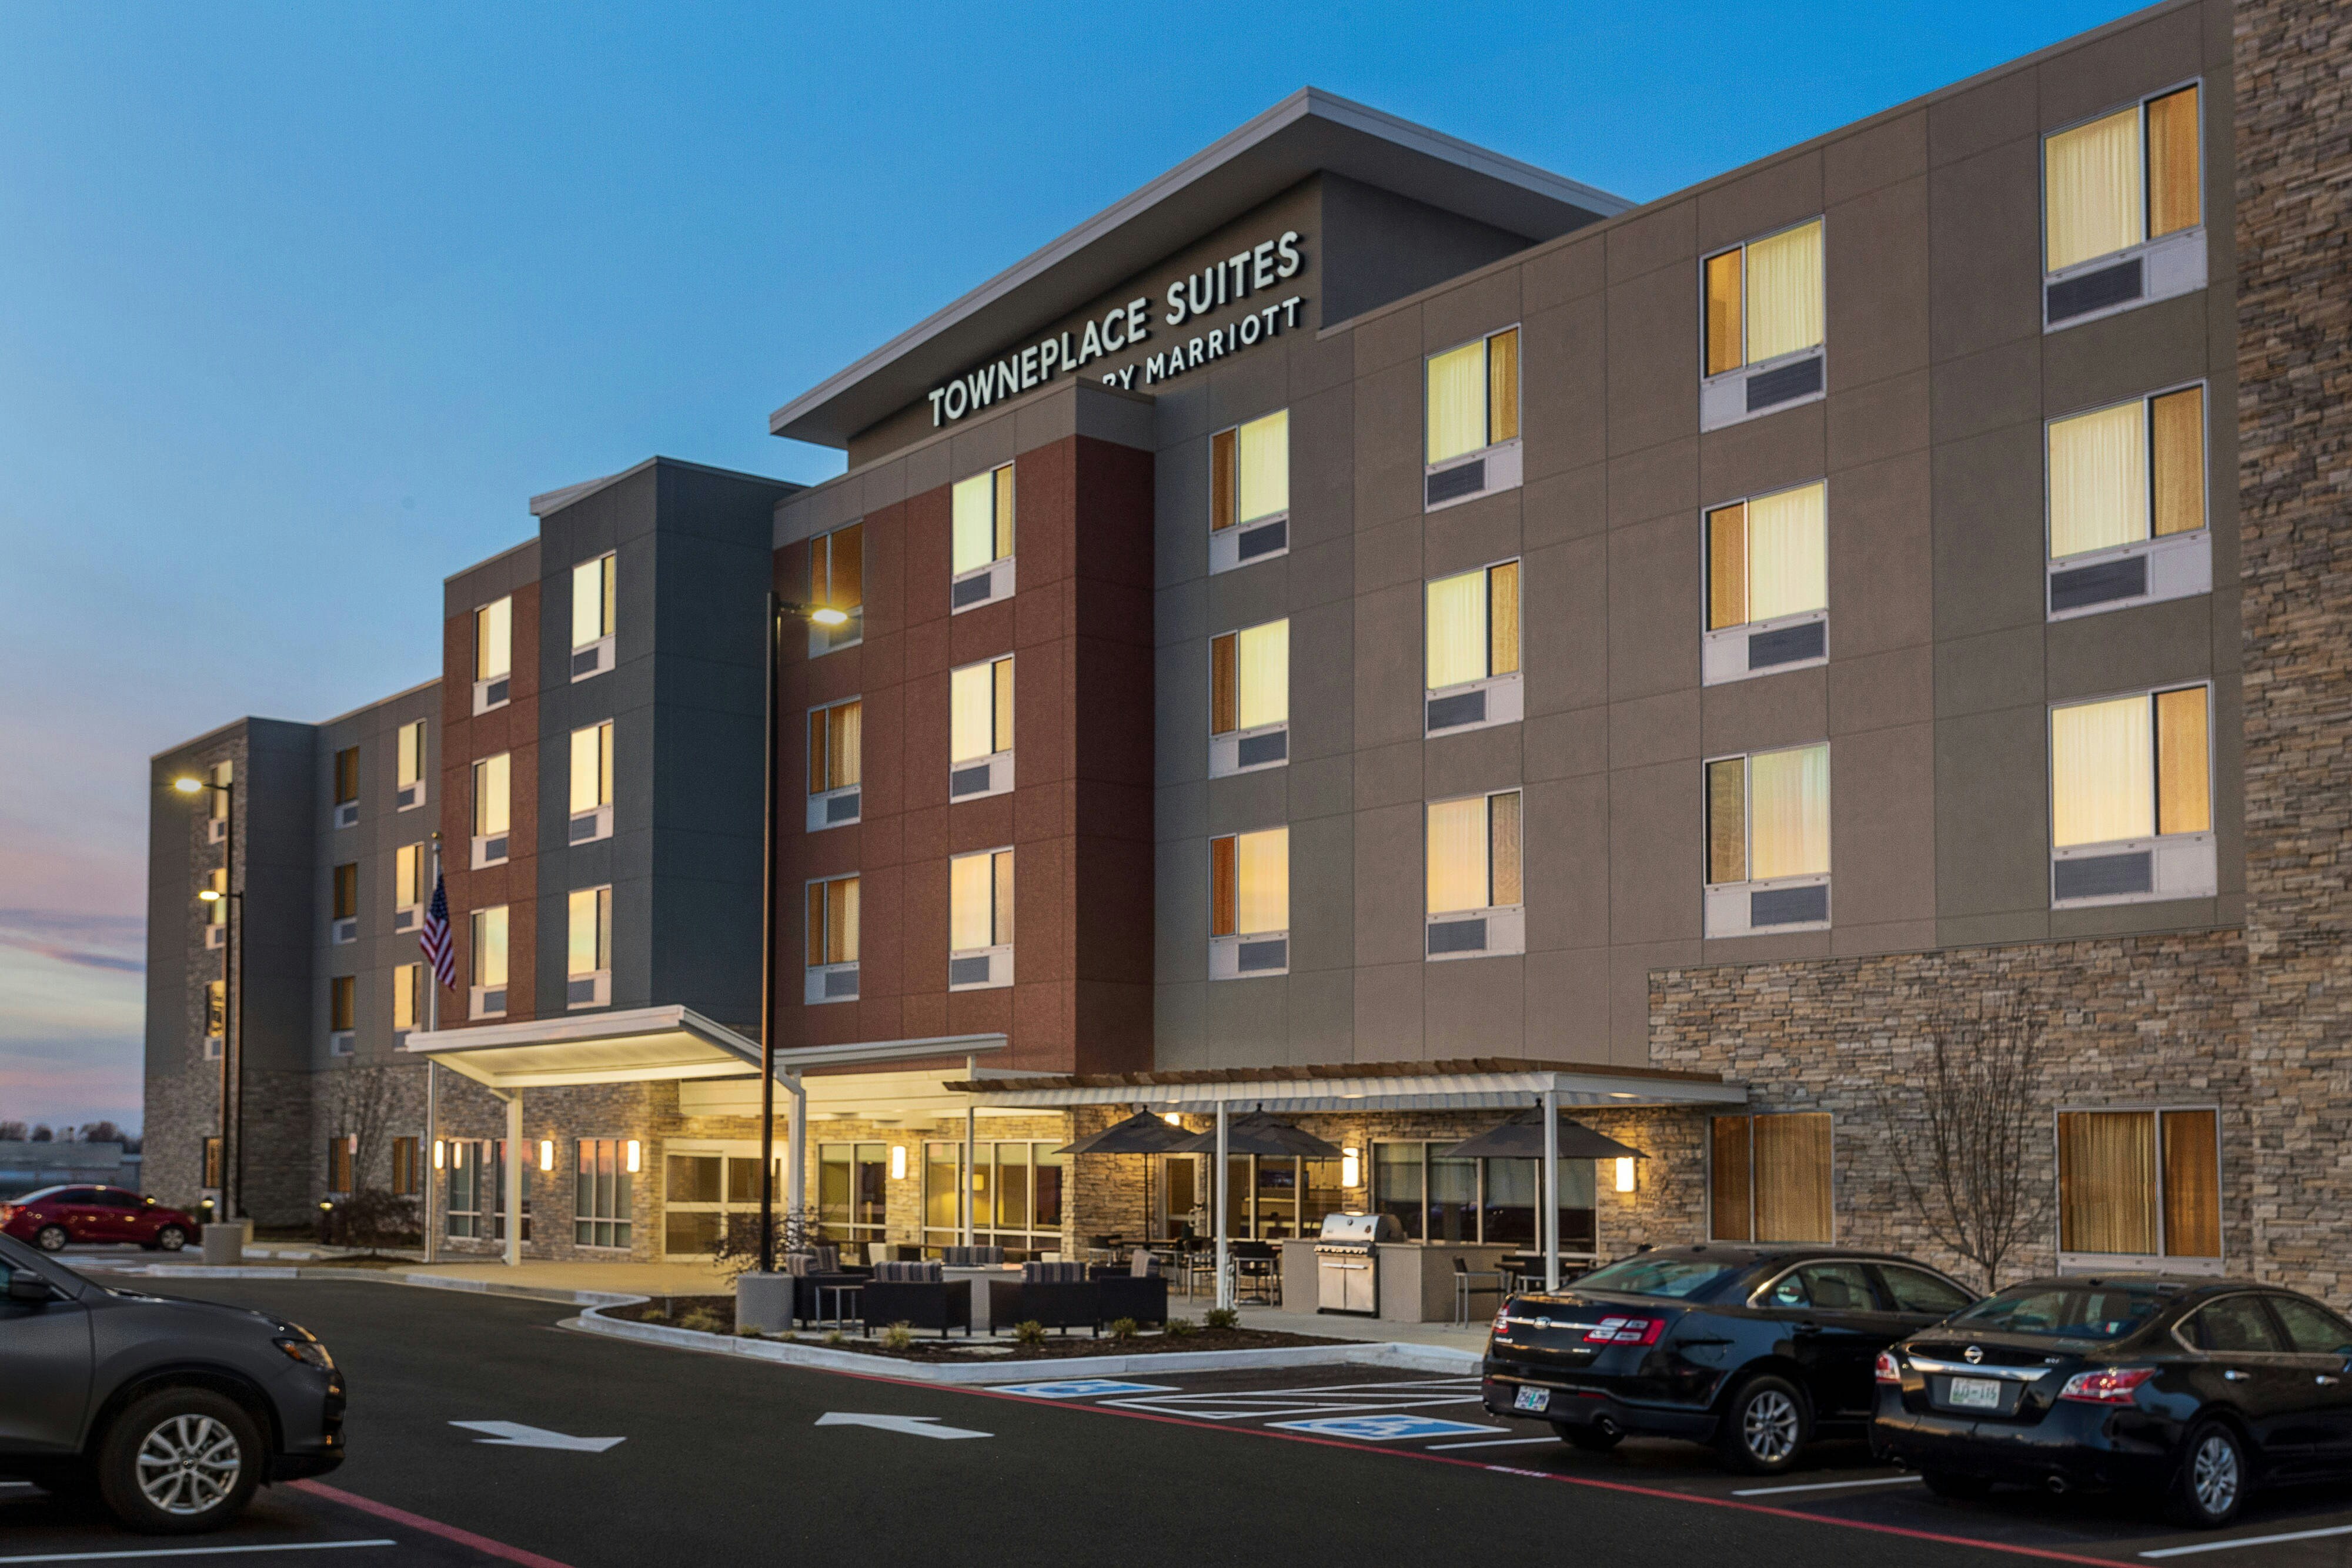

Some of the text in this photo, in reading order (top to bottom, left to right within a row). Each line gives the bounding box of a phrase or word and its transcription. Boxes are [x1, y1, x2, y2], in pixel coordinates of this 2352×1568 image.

[928, 230, 1299, 427] TOWNEPLACE SUITES
[1146, 296, 1301, 384] MARRIOTT
